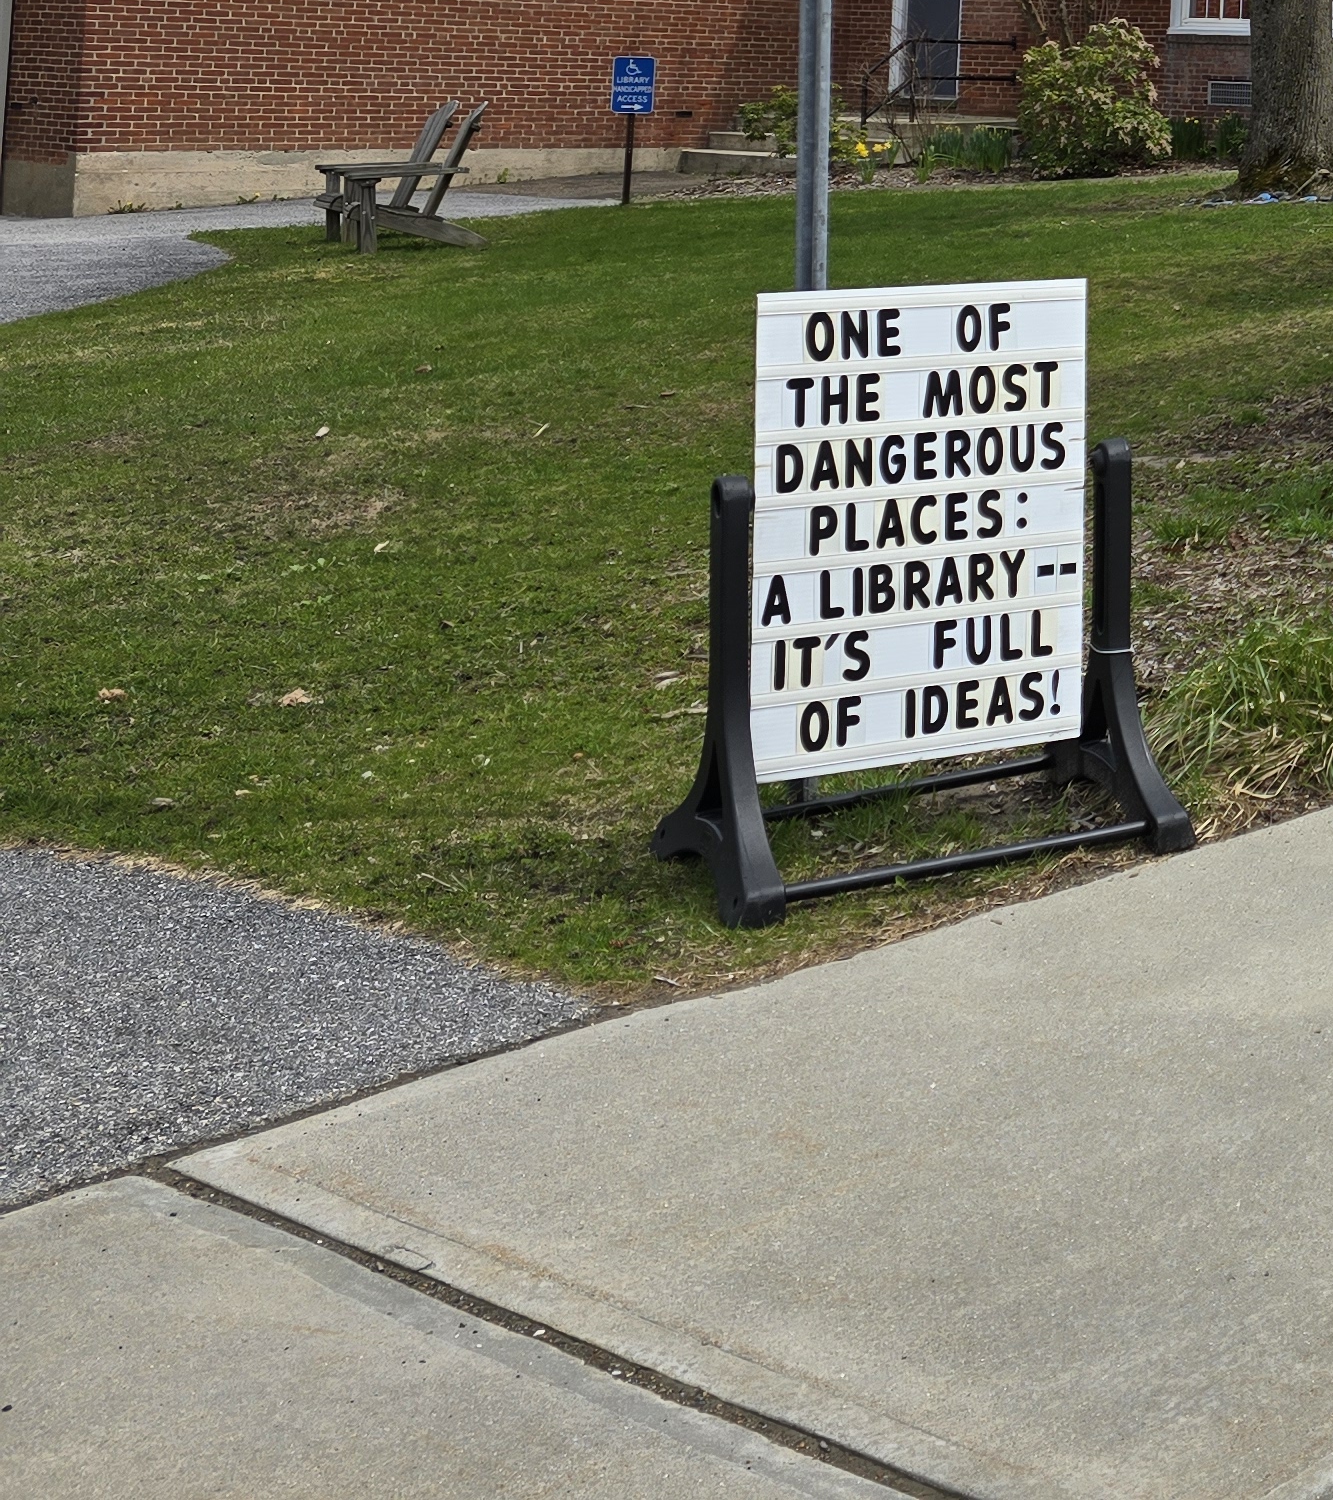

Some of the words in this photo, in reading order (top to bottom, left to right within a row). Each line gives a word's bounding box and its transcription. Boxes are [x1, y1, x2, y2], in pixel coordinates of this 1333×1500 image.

[613, 85, 653, 93] HANDICAPPED
[616, 76, 650, 84] LIBRARY
[616, 95, 648, 103] ACCESS
[804, 307, 902, 363] ONE
[955, 301, 1012, 354] OF
[784, 371, 881, 429] THE
[922, 360, 1060, 420] MOST
[774, 420, 1067, 495] DANGEROUS
[808, 487, 1029, 558] PLACES:
[760, 572, 792, 628] A
[772, 628, 873, 693] IT'S
[932, 607, 1054, 672] FULL
[799, 694, 863, 754] OF
[903, 667, 1062, 740] IDEAS!
